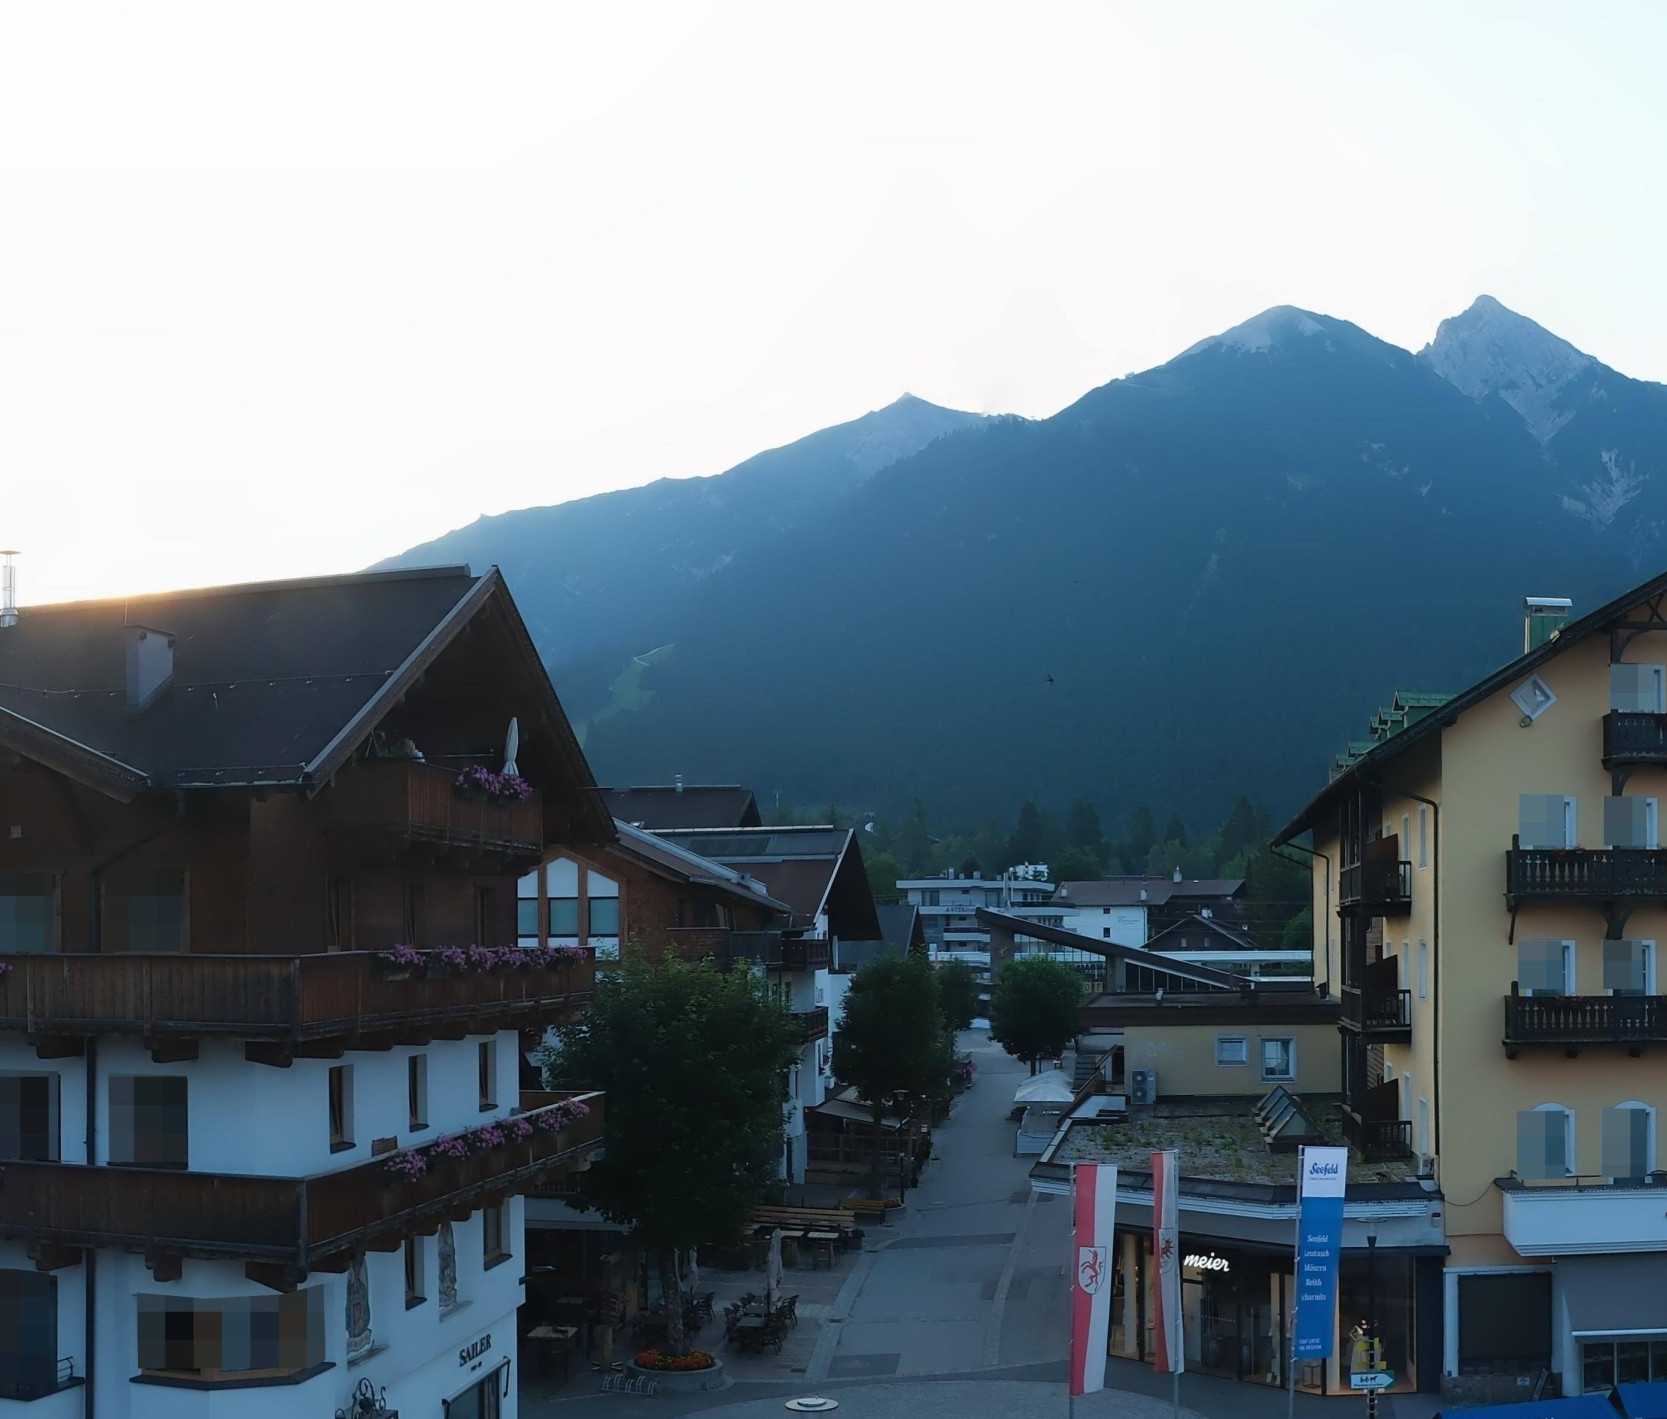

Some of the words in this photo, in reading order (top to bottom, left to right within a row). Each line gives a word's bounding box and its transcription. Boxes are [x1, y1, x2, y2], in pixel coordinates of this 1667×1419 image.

[1310, 1162, 1339, 1176] Seefeld
[1183, 1252, 1230, 1273] meier
[1301, 1293, 1327, 1302] charnitz
[459, 1333, 492, 1368] SAILER
